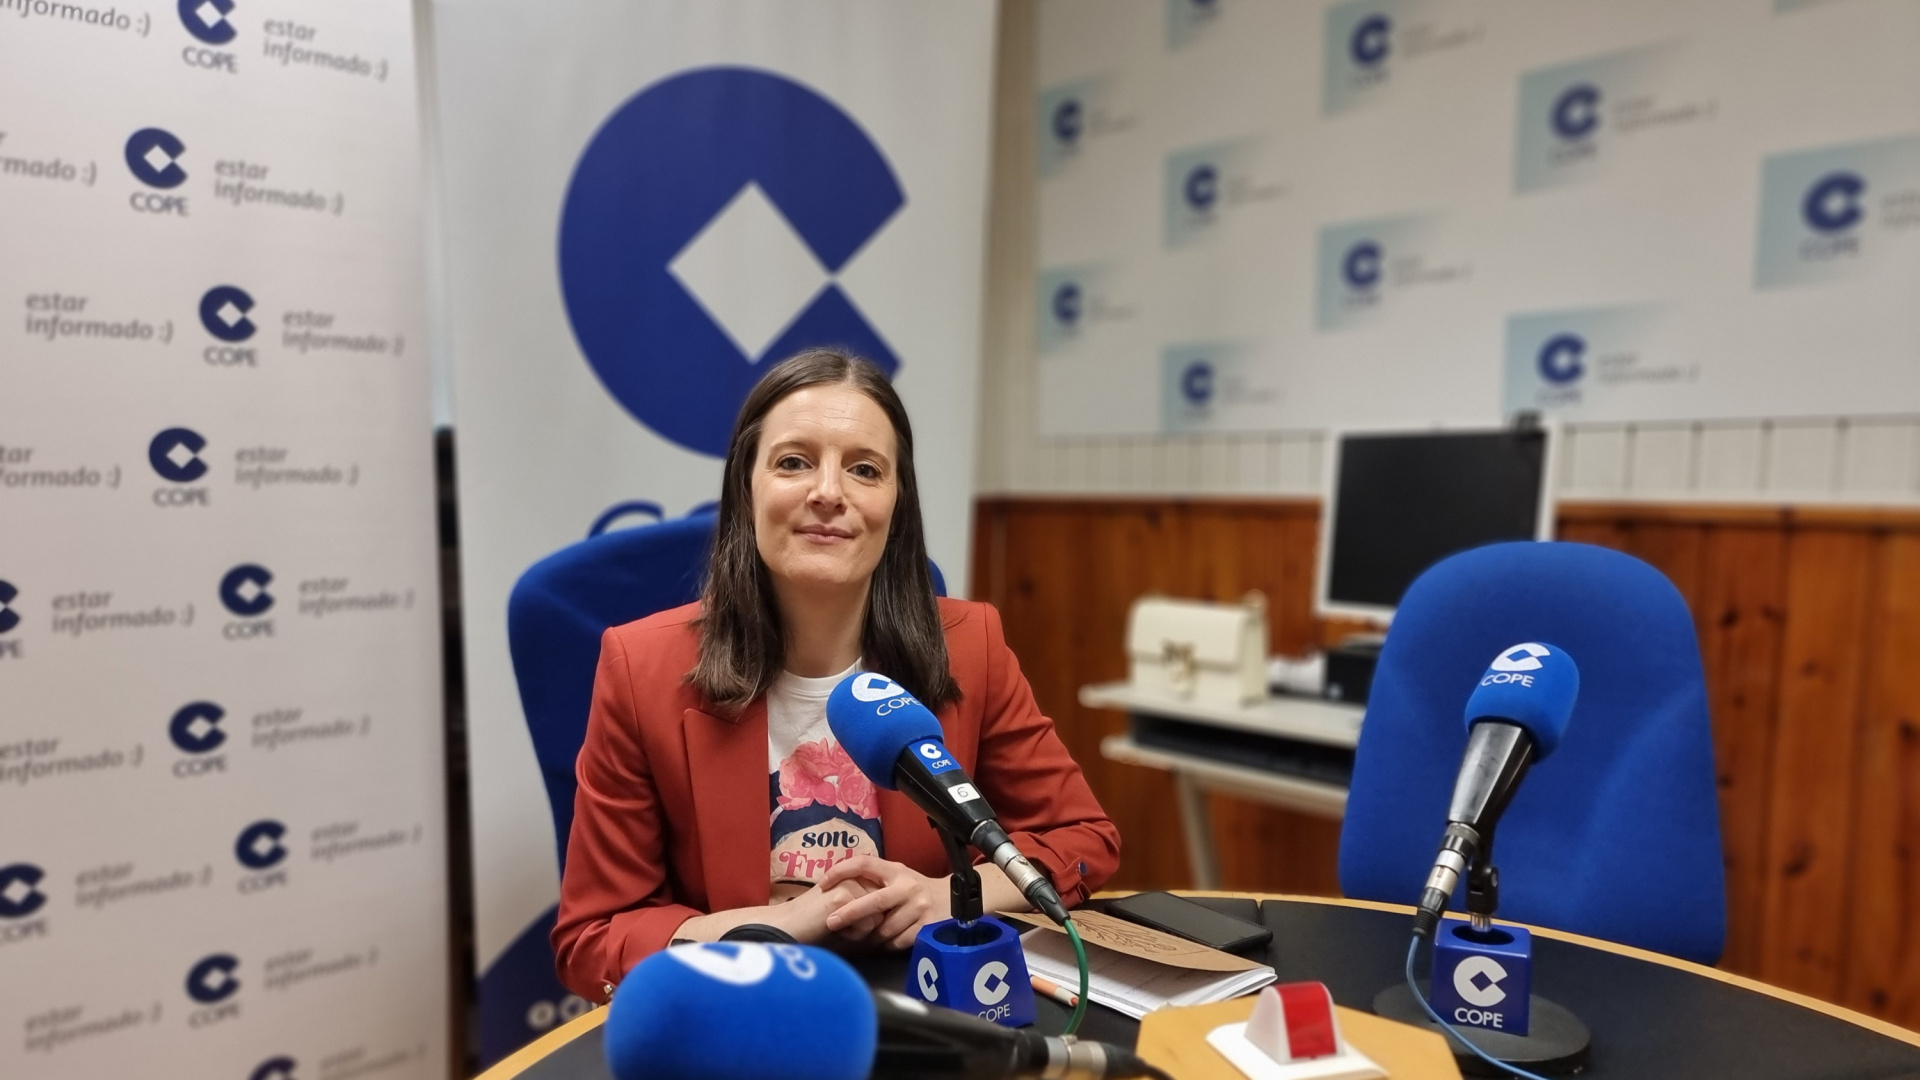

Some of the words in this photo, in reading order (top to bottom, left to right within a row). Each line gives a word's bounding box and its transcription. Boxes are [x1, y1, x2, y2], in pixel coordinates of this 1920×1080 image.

[262, 18, 316, 42] estar
[182, 46, 238, 74] COPE
[263, 39, 371, 77] informado
[129, 191, 188, 217] COPE
[214, 179, 327, 211] informado
[26, 293, 87, 313] estar
[26, 314, 153, 341] informado
[203, 345, 258, 367] COPE
[153, 488, 209, 507] COPE
[1481, 673, 1534, 688] COPE
[876, 696, 921, 716] COPE
[931, 759, 952, 769] COPE
[957, 786, 969, 798] 6
[801, 830, 860, 849] son
[1454, 1007, 1504, 1028] COPE
